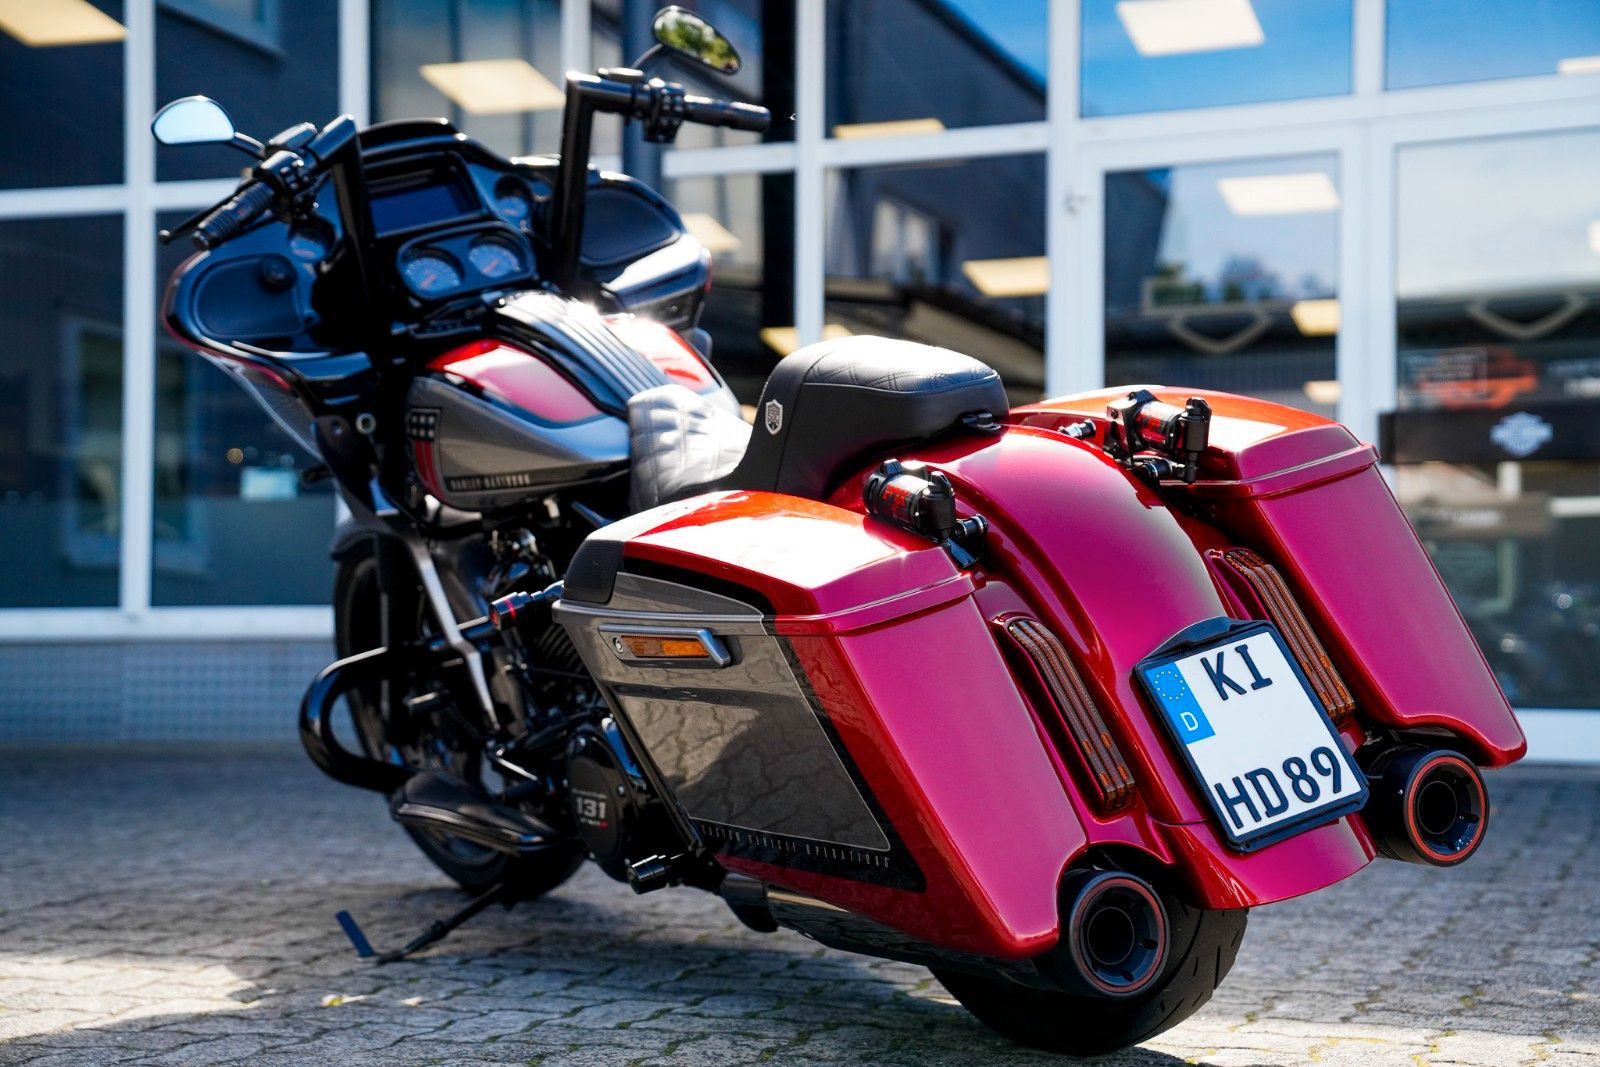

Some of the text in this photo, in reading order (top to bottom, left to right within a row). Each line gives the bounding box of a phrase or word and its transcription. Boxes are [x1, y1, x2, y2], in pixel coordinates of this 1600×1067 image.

[1200, 643, 1273, 701] KI
[1180, 711, 1199, 731] D
[576, 797, 606, 819] 131
